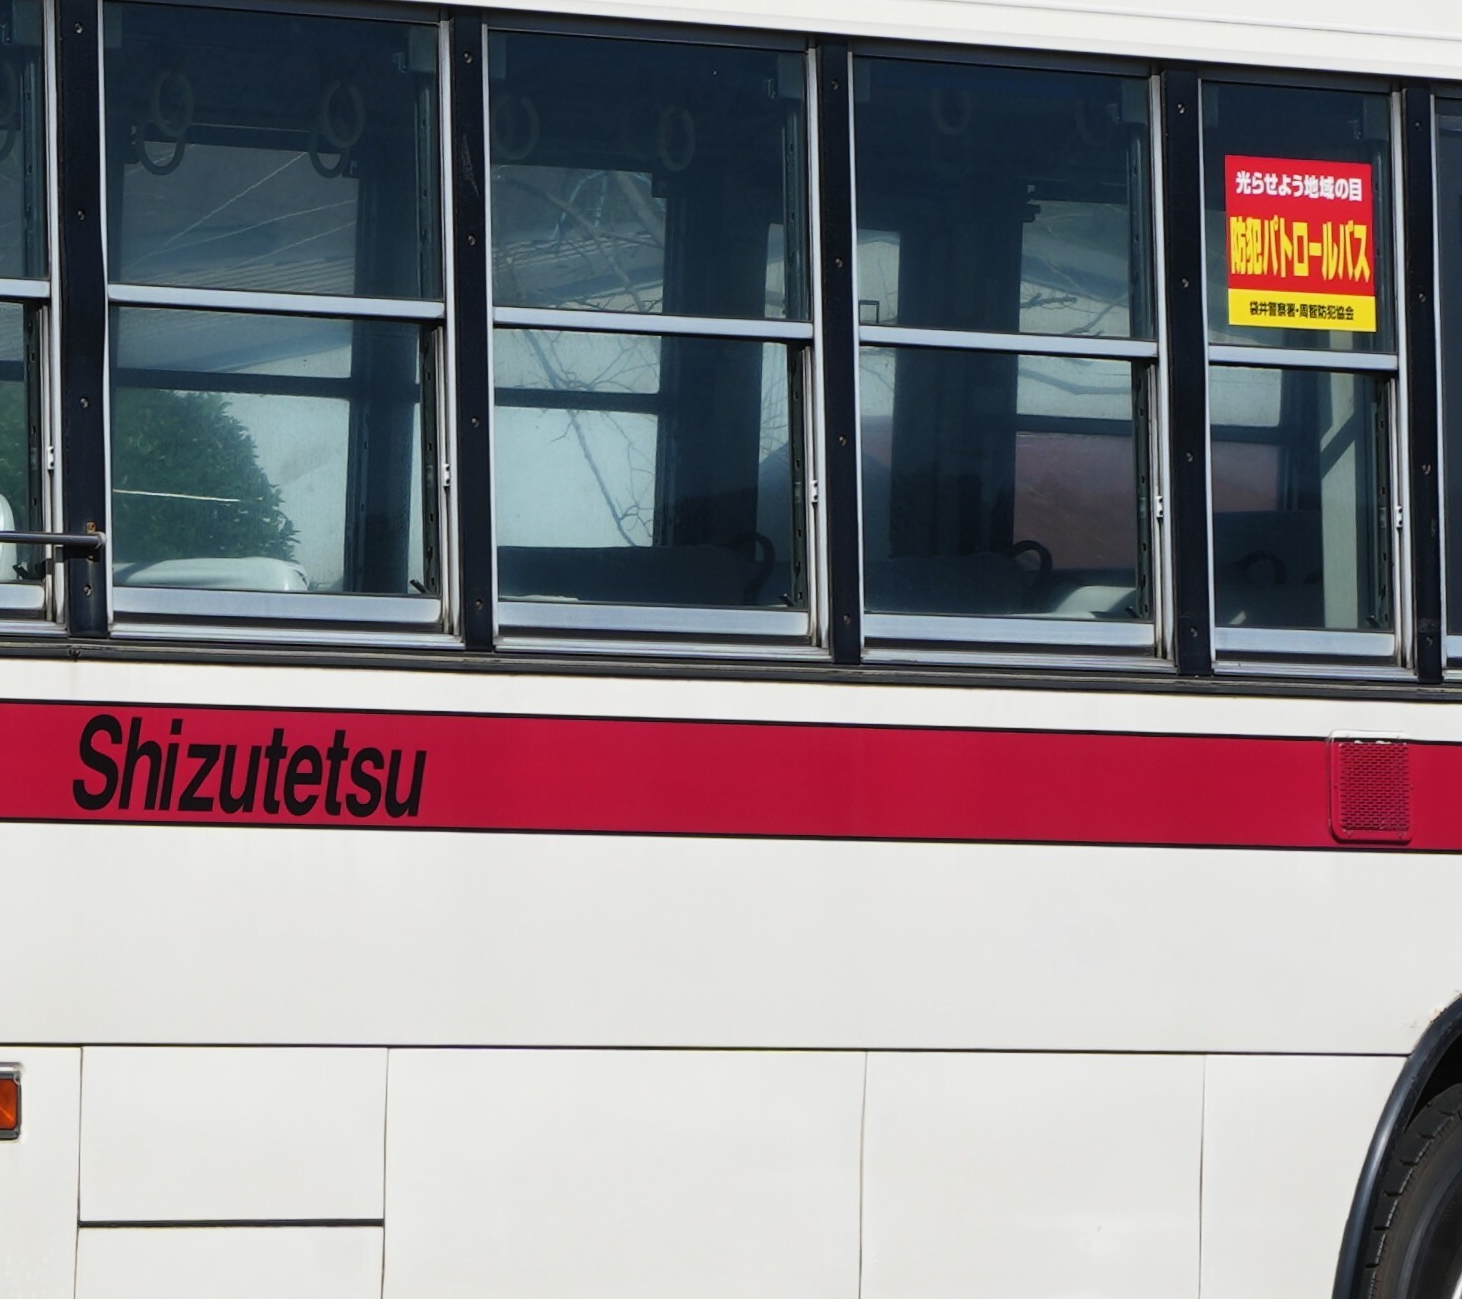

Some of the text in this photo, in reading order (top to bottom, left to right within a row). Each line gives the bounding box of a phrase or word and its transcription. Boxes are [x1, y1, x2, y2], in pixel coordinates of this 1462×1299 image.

[1235, 170, 1363, 203] 光らせよう地域の目
[1229, 214, 1371, 284] 防犯パトロールバス
[72, 713, 428, 819] Shizutetsu
